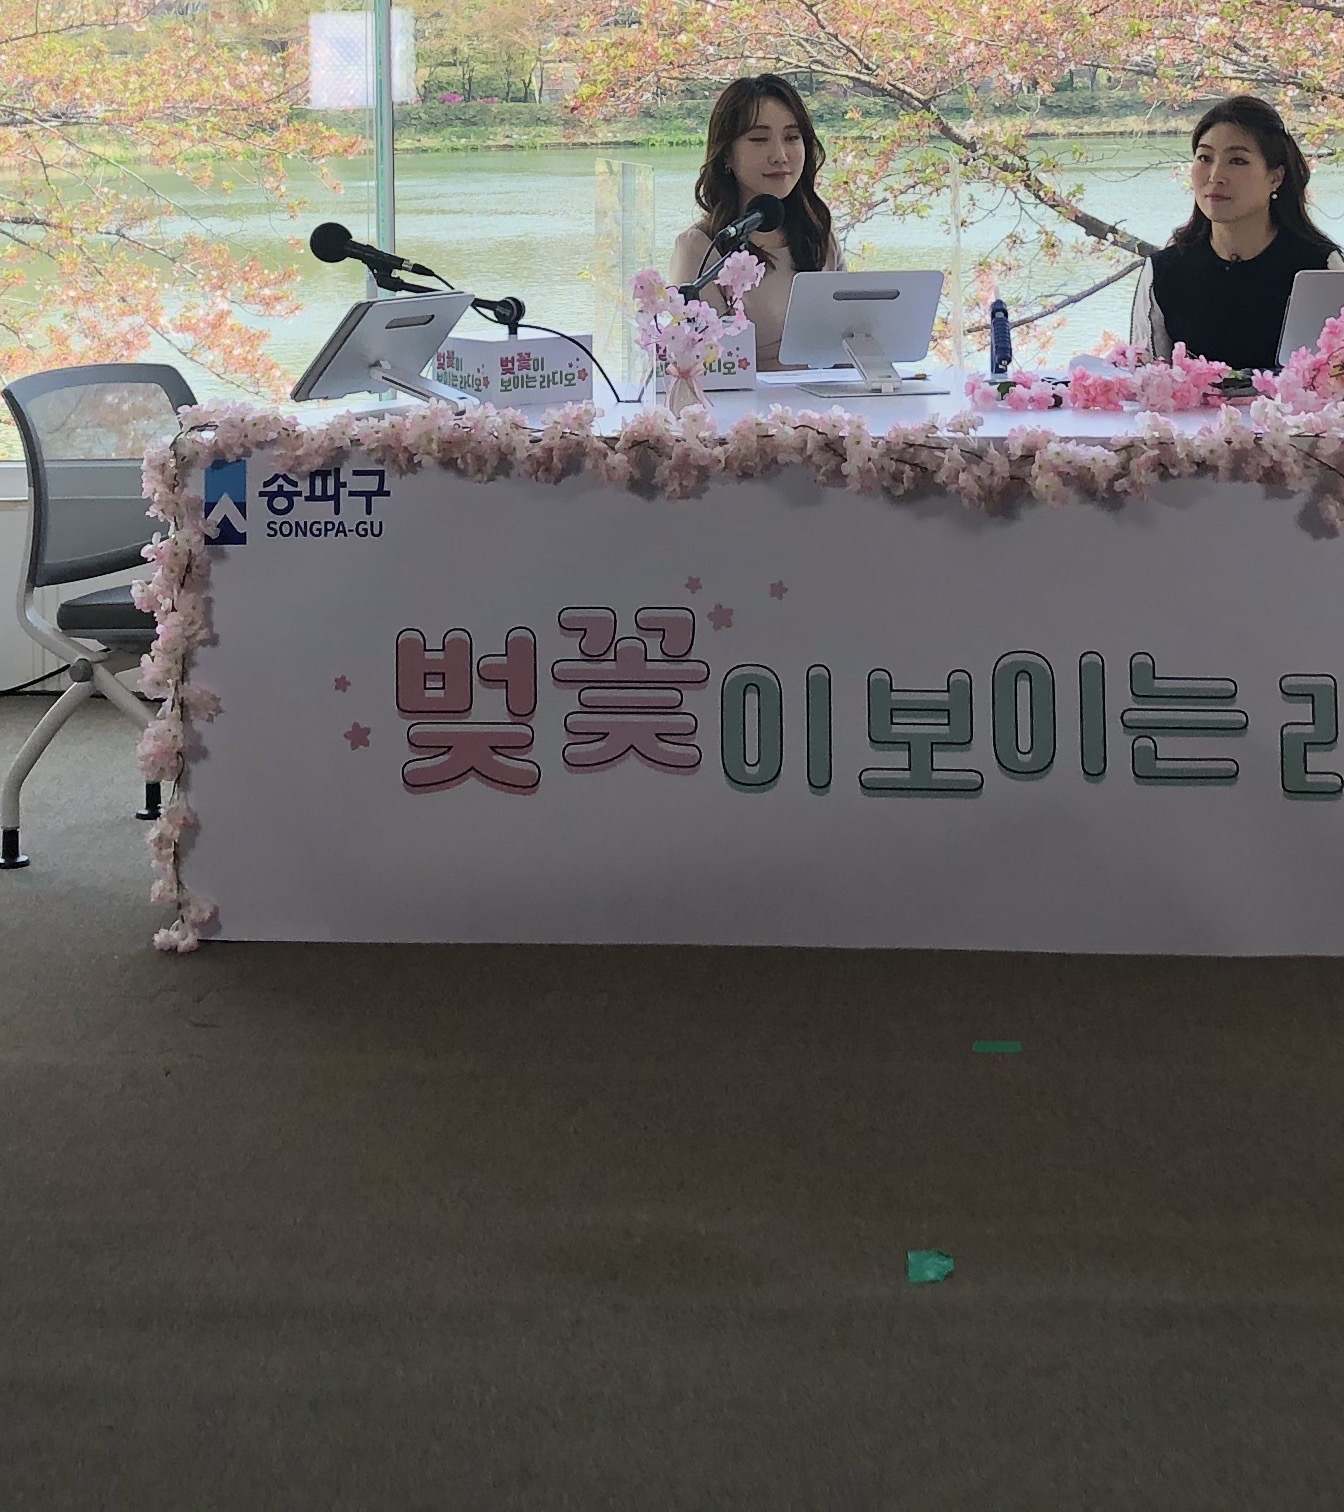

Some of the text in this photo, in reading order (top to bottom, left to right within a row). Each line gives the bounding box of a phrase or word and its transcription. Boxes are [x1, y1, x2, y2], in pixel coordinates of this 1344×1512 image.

[499, 351, 545, 376] 벚꽃이
[499, 369, 577, 393] 보이는 라디오
[258, 467, 392, 516] 송파구
[266, 520, 384, 539] SONGPA-GU
[395, 604, 832, 798] 벚꽃이
[857, 648, 1249, 799] 보이는
